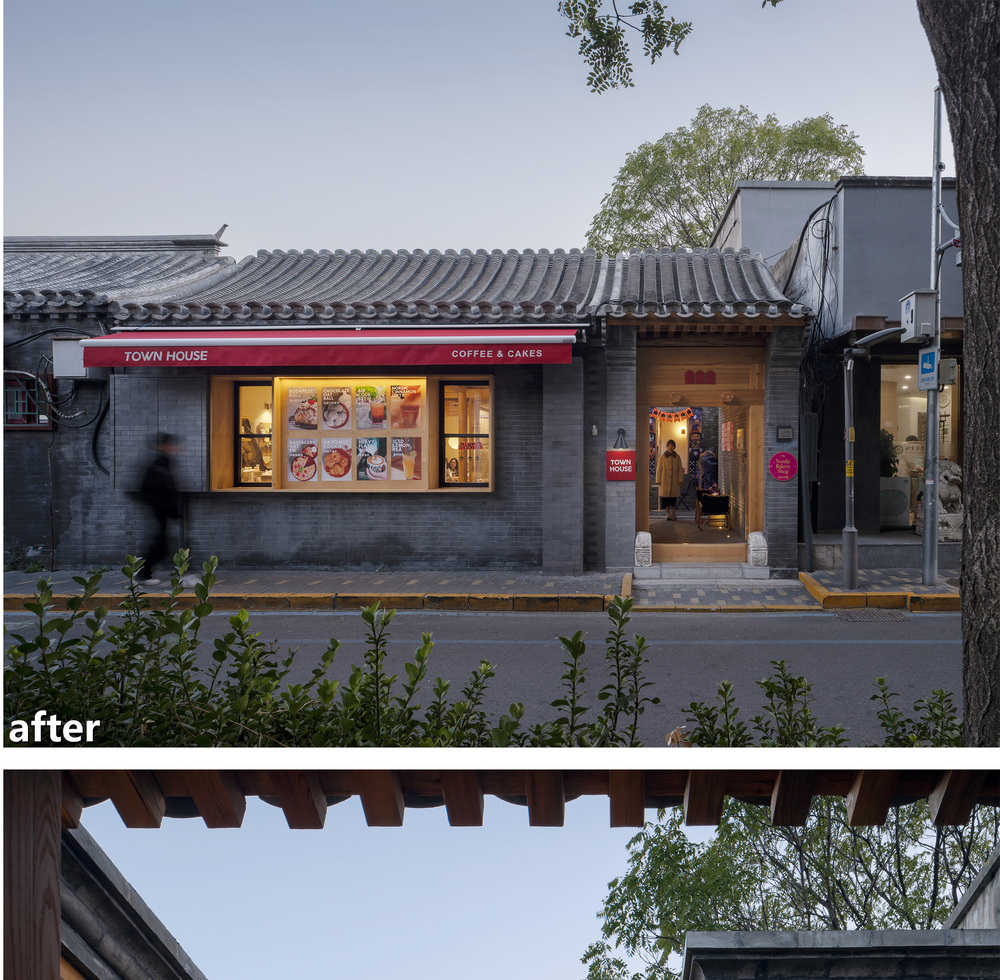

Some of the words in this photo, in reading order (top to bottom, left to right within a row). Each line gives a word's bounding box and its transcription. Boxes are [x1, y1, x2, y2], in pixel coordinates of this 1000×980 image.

[124, 351, 163, 362] TOWN
[166, 351, 208, 362] HOUSE
[451, 349, 493, 358] COFFEE
[496, 349, 504, 358] &
[507, 349, 543, 358] CAKES
[609, 465, 633, 473] HOUSE
